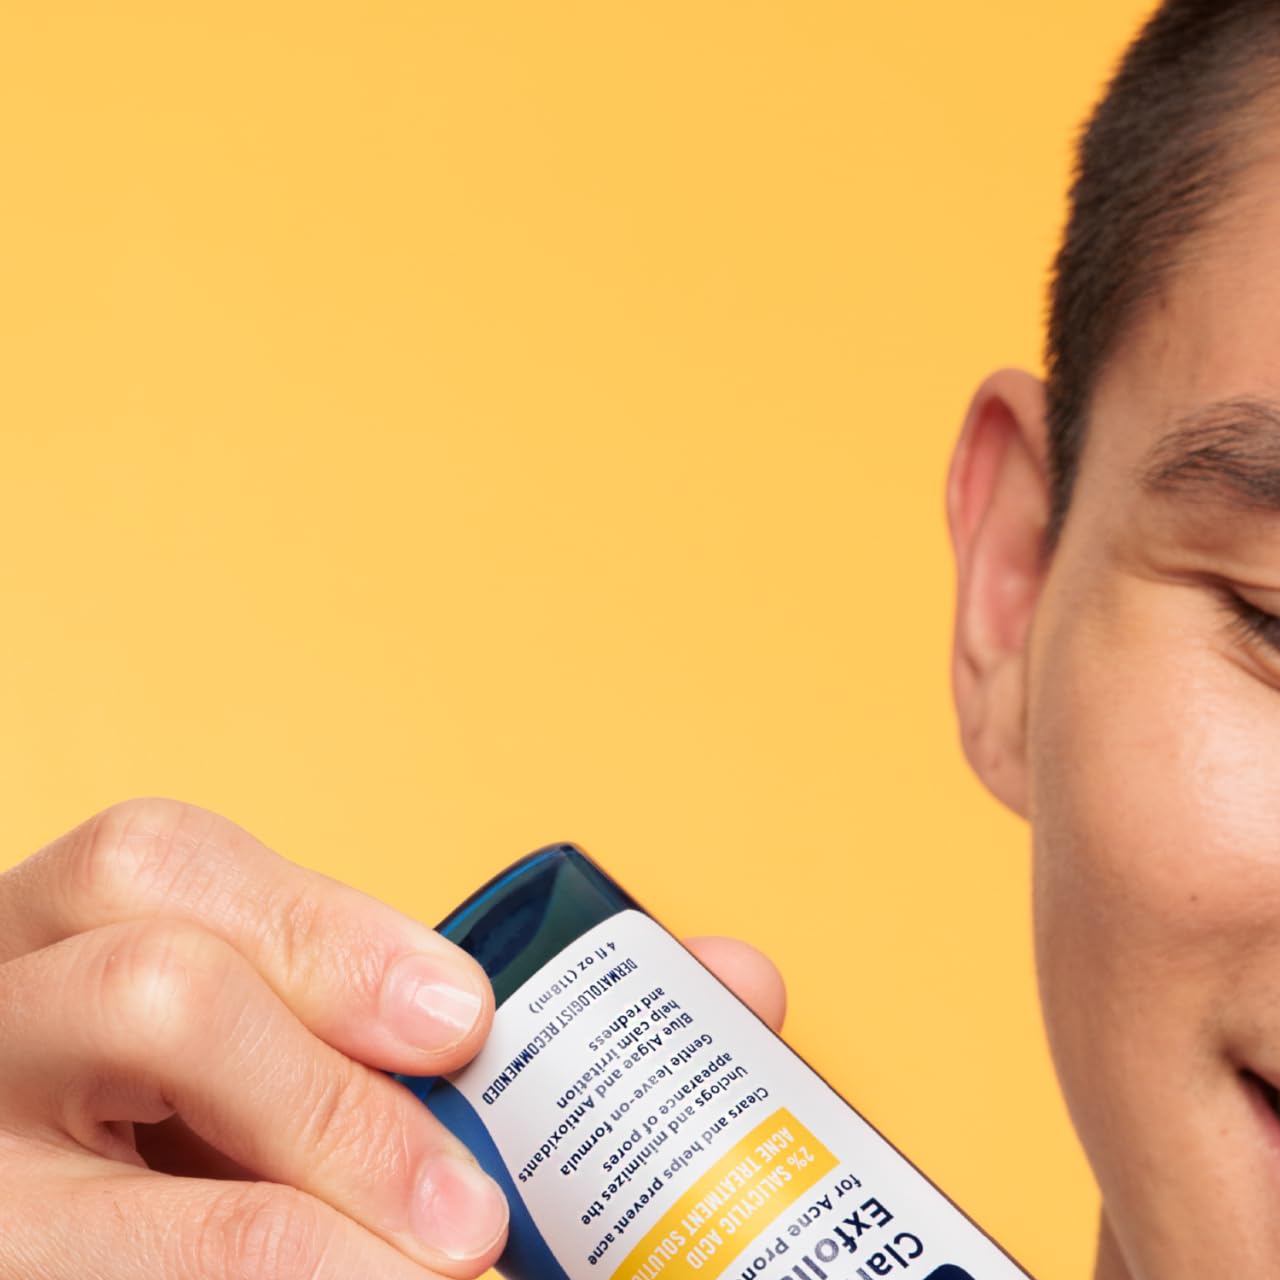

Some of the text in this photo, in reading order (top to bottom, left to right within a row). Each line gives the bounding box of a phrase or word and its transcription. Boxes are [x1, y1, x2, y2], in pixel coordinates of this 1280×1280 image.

[481, 957, 639, 1106] DERMATOLOGIST RECOMMENDED
[528, 941, 616, 1014] 4 fl oz (118ml)
[588, 987, 666, 1052] and redness
[517, 1011, 694, 1184] Blue Algae and Antioxidants
[555, 999, 682, 1110] help calm irritation
[559, 1033, 713, 1176] Gentle leave-on formula
[602, 1052, 734, 1173] appearance of pores
[580, 1065, 749, 1226] Unclogs and minimizes the
[587, 1086, 770, 1266] Clears and helps prevent acne
[682, 1157, 762, 1235] TREATMENT
[754, 1127, 794, 1163] ACNE
[833, 1173, 863, 1199] for
[686, 1145, 815, 1269] 2% SALICYLIC ACID
[787, 1193, 834, 1237] Acne
